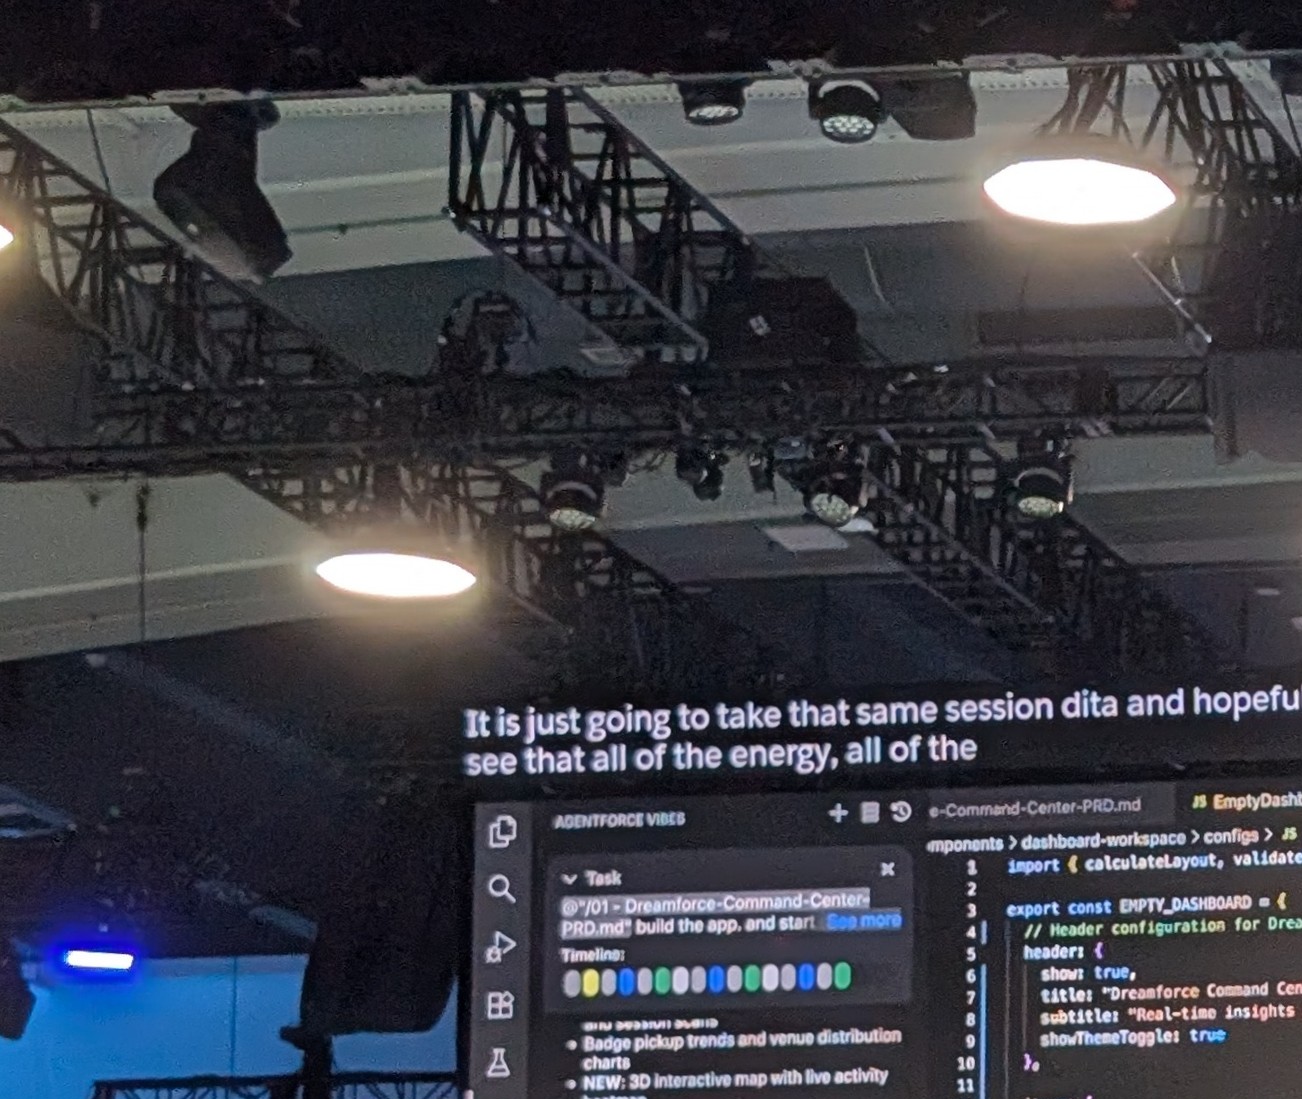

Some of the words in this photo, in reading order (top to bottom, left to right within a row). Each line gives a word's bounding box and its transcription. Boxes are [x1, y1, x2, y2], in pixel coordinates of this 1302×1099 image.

[464, 709, 490, 738] It
[495, 707, 520, 736] is
[524, 706, 581, 741] just
[584, 704, 671, 740] going
[677, 704, 710, 730] to
[716, 702, 782, 729] take
[788, 699, 850, 727] that
[856, 701, 938, 725] same
[944, 692, 1054, 722] session
[1060, 689, 1118, 718] dita
[1126, 688, 1184, 716] and
[464, 752, 518, 775] see
[522, 746, 586, 773] that
[590, 744, 626, 772] all
[633, 742, 667, 770] of
[672, 742, 722, 769] the
[728, 743, 838, 771] energy,
[844, 736, 881, 764] all
[888, 734, 922, 762] of
[927, 734, 978, 761] the
[1203, 828, 1259, 846] configs
[1006, 901, 1060, 919] export
[1067, 900, 1112, 915] const
[635, 918, 674, 934] build
[677, 917, 704, 933] the
[744, 915, 776, 931] and
[1050, 922, 1103, 936] Header
[1111, 919, 1226, 936] configuration
[1234, 917, 1260, 931] for
[582, 1035, 632, 1053] Badge
[633, 1034, 684, 1052] pickup
[686, 1032, 735, 1048] trends
[737, 1031, 766, 1047] and
[768, 1032, 814, 1046] venue
[816, 1028, 902, 1045] distribution
[582, 1055, 630, 1070] charts
[628, 1073, 651, 1090] 3D
[653, 1072, 732, 1088] interactive
[734, 1073, 768, 1087] map
[770, 1069, 802, 1085] with
[804, 1068, 831, 1084] live
[833, 1067, 888, 1085] activity
